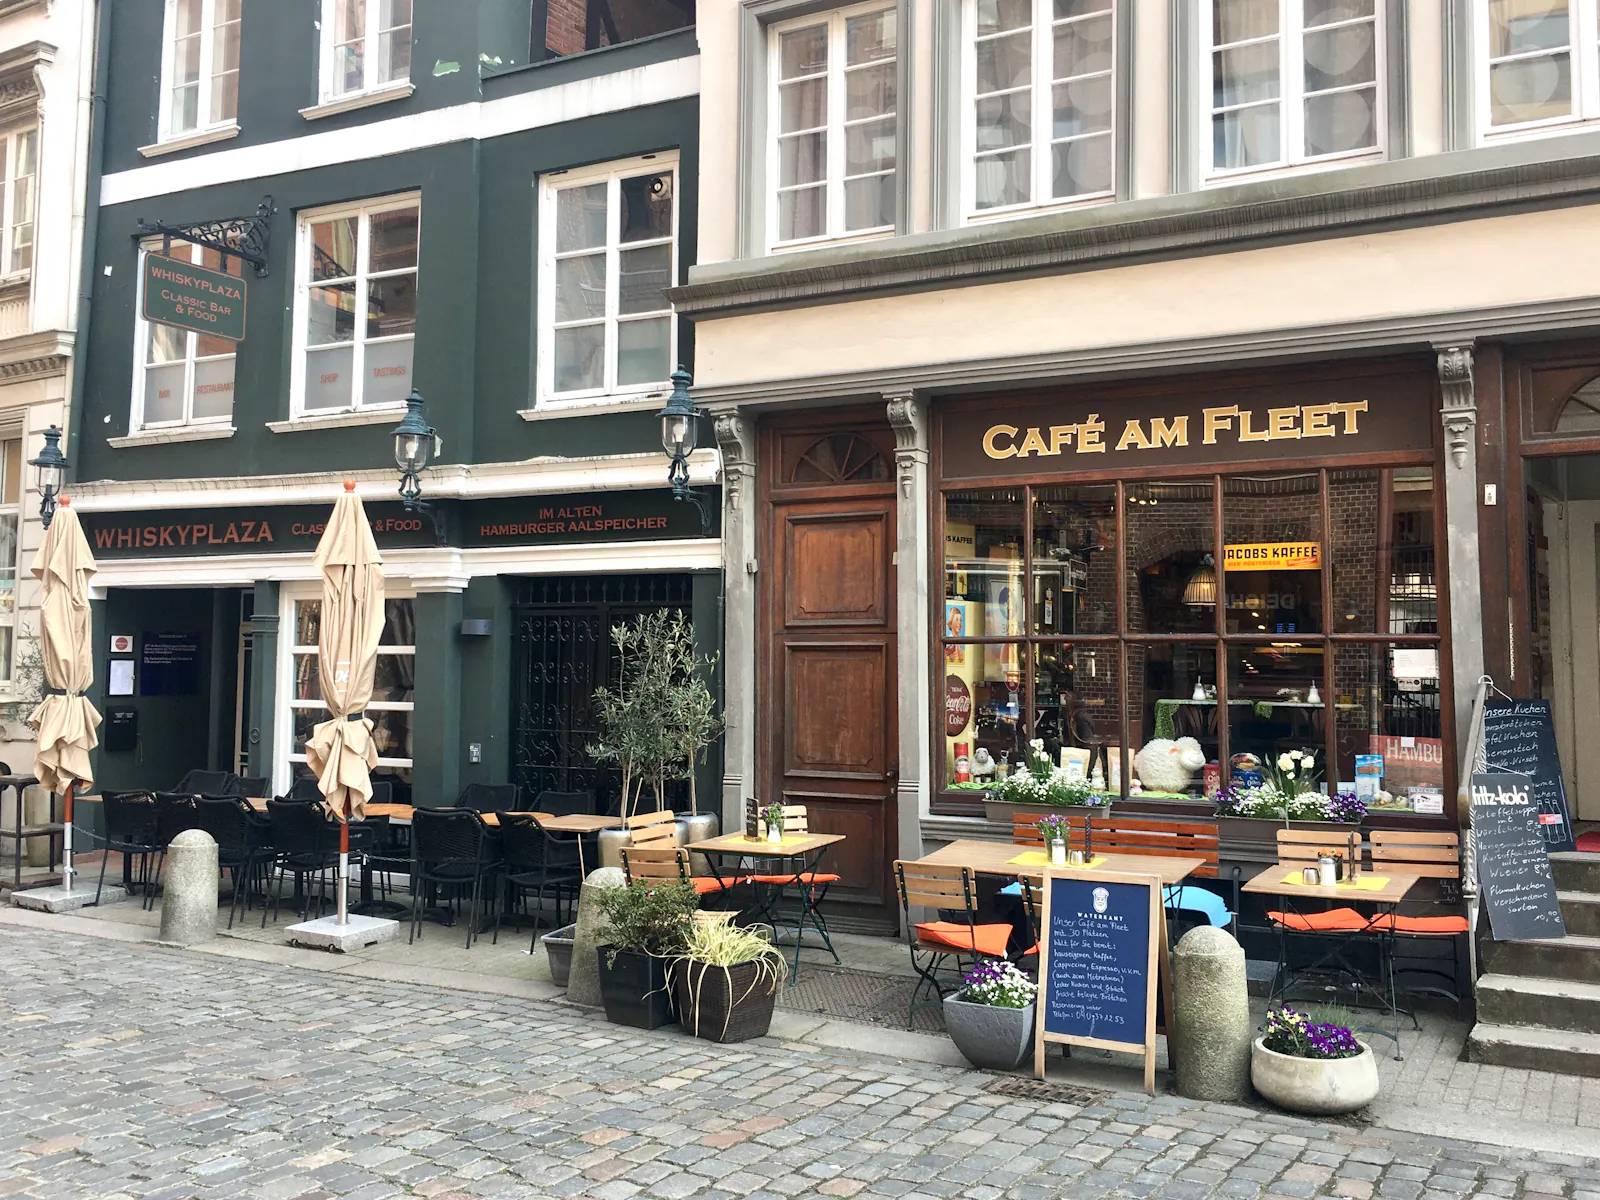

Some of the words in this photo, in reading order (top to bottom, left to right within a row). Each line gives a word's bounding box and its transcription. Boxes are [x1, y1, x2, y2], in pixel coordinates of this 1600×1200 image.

[151, 267, 241, 300] WHISKYPLAZA
[161, 289, 207, 309] CLASSIC
[210, 302, 231, 315] BAR
[175, 304, 184, 314] &
[187, 307, 217, 322] FOOD
[320, 373, 339, 384] SHOP
[373, 366, 406, 378] TASTINGS
[197, 381, 235, 394] RESTAURANT
[982, 413, 1106, 460] CAFÉ
[1114, 415, 1189, 451] AM
[1202, 399, 1369, 446] FLEET
[539, 508, 555, 520] IM
[557, 505, 603, 518] ALTEN
[375, 519, 384, 532] &
[385, 518, 423, 531] FOOD
[480, 521, 565, 537] HAMBURGER
[568, 517, 668, 532] AALSPEICHER
[95, 521, 274, 549] WHISKYPLAZA
[952, 535, 973, 544] KAFFEE
[1272, 546, 1318, 557] KAFFEE
[1514, 702, 1547, 714] Kuchen
[1472, 785, 1530, 806] fritz-kola
[1053, 916, 1076, 927] Unser
[1078, 918, 1095, 929] Café
[1077, 912, 1123, 922] WATERKANT
[1053, 929, 1067, 937] mit
[1067, 929, 1080, 937] 30
[1070, 939, 1080, 949] für
[1081, 939, 1092, 948] Sie
[1053, 949, 1091, 959] hauseigenen
[1091, 983, 1103, 991] und
